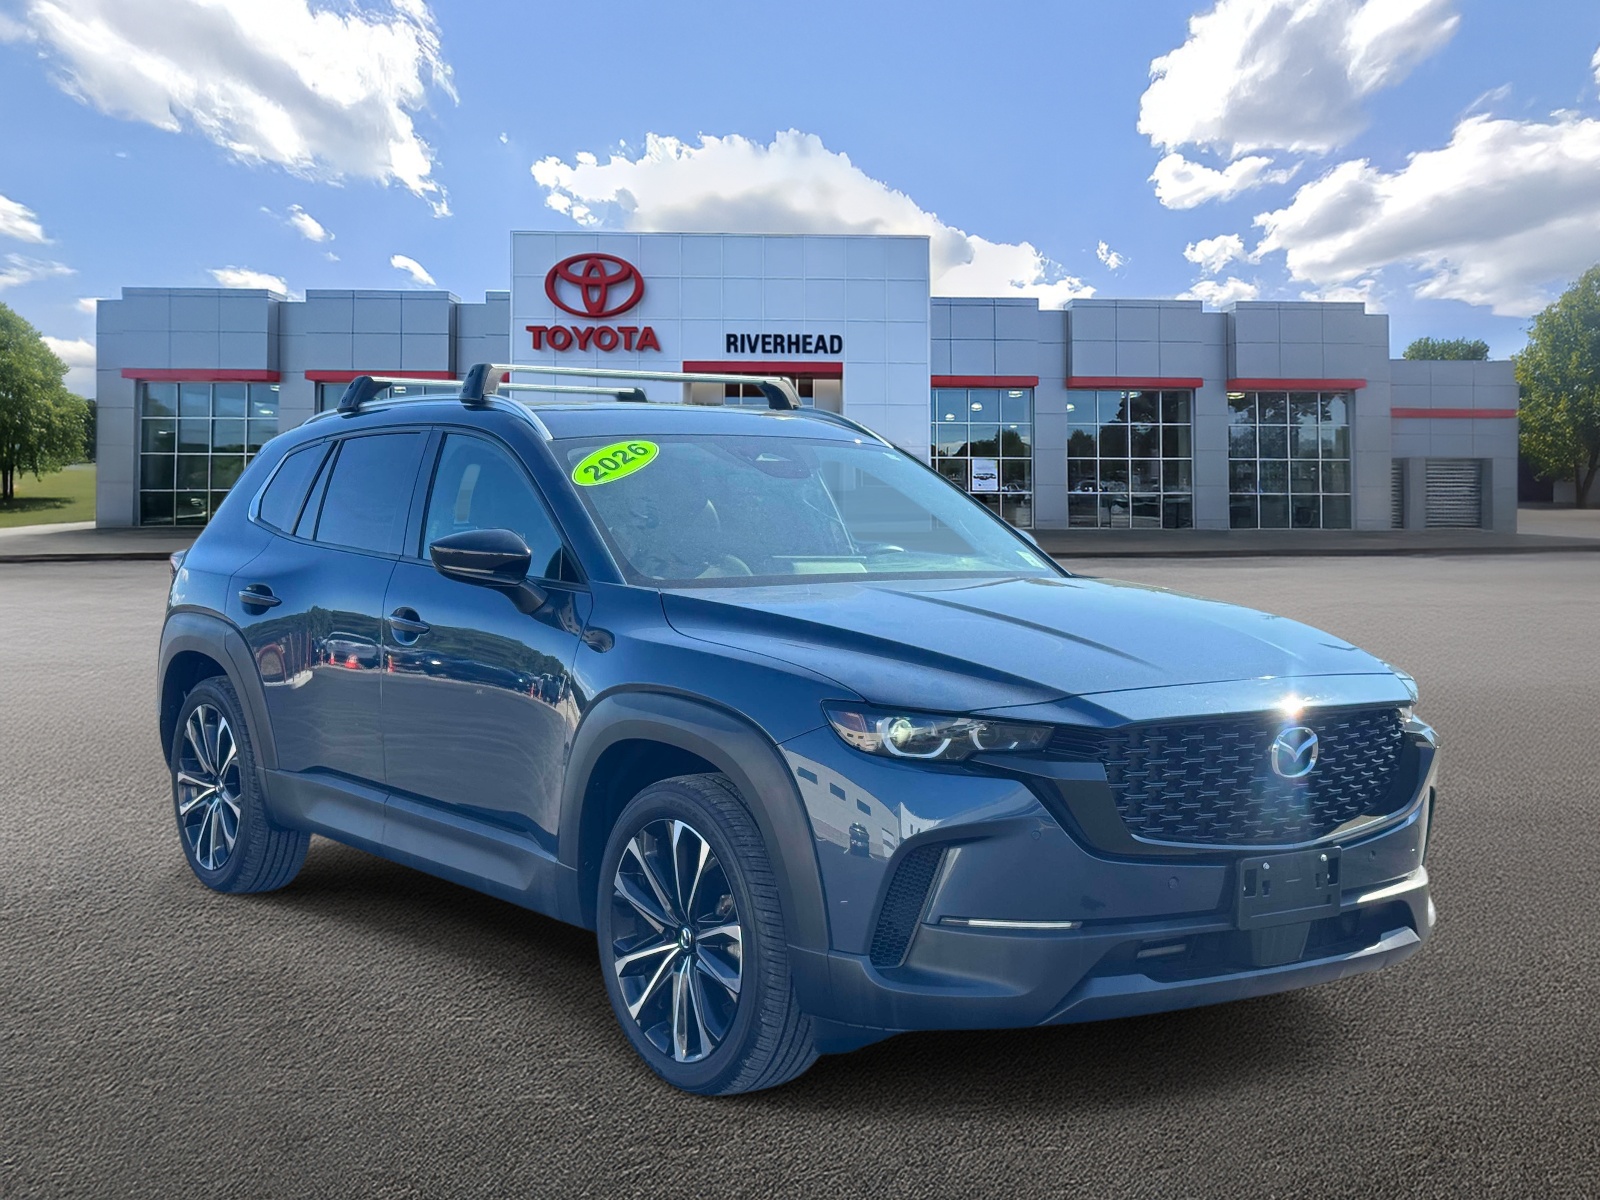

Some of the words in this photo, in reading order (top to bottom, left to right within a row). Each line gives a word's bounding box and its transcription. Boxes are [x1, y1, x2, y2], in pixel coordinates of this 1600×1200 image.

[526, 325, 661, 352] TOYOTA
[726, 333, 843, 354] RIVERHEAD
[583, 443, 649, 482] 2026
